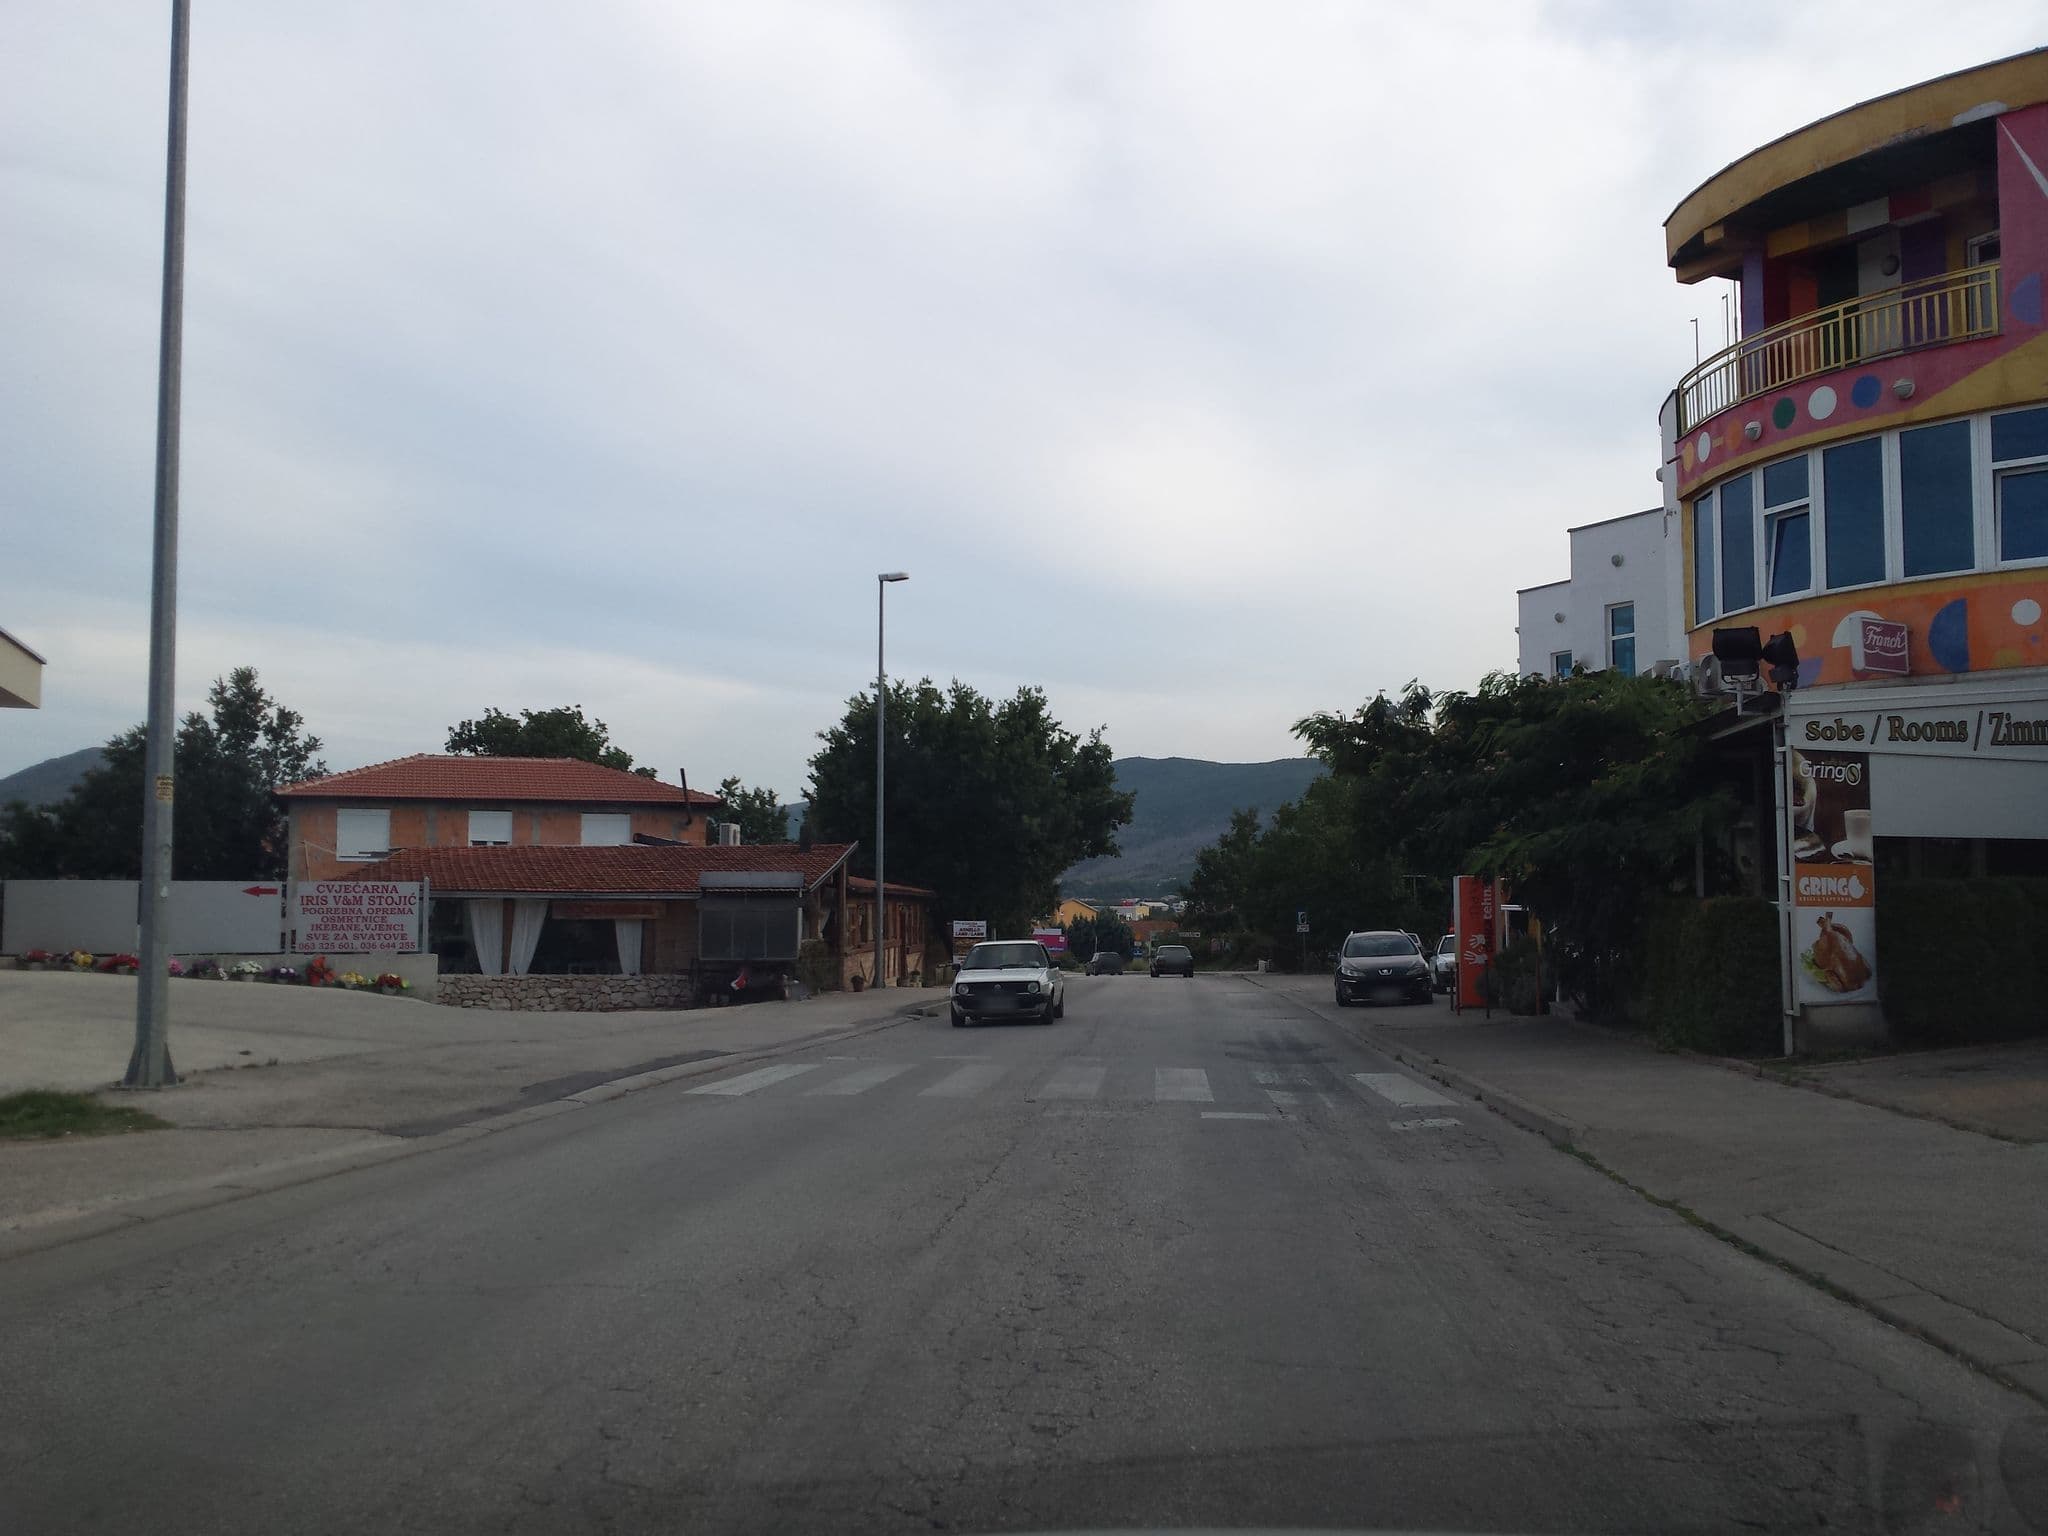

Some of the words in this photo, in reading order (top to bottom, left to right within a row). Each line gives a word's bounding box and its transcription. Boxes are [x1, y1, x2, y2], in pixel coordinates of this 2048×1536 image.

[1805, 717, 1866, 742] Sobe
[1887, 715, 1969, 743] Rooms
[316, 881, 399, 894] CVJEĆARNA
[1798, 875, 1866, 900] GRINGO
[300, 895, 328, 906] IRIS
[333, 895, 363, 906] V&M
[367, 892, 417, 906] STOJIĆ
[302, 907, 363, 915] POGREBNA
[366, 907, 414, 915] OPREMA
[320, 915, 388, 923] OSMRTNICE
[306, 933, 329, 941] SVE
[334, 933, 348, 941] ZA
[352, 933, 408, 941] SVATOVE
